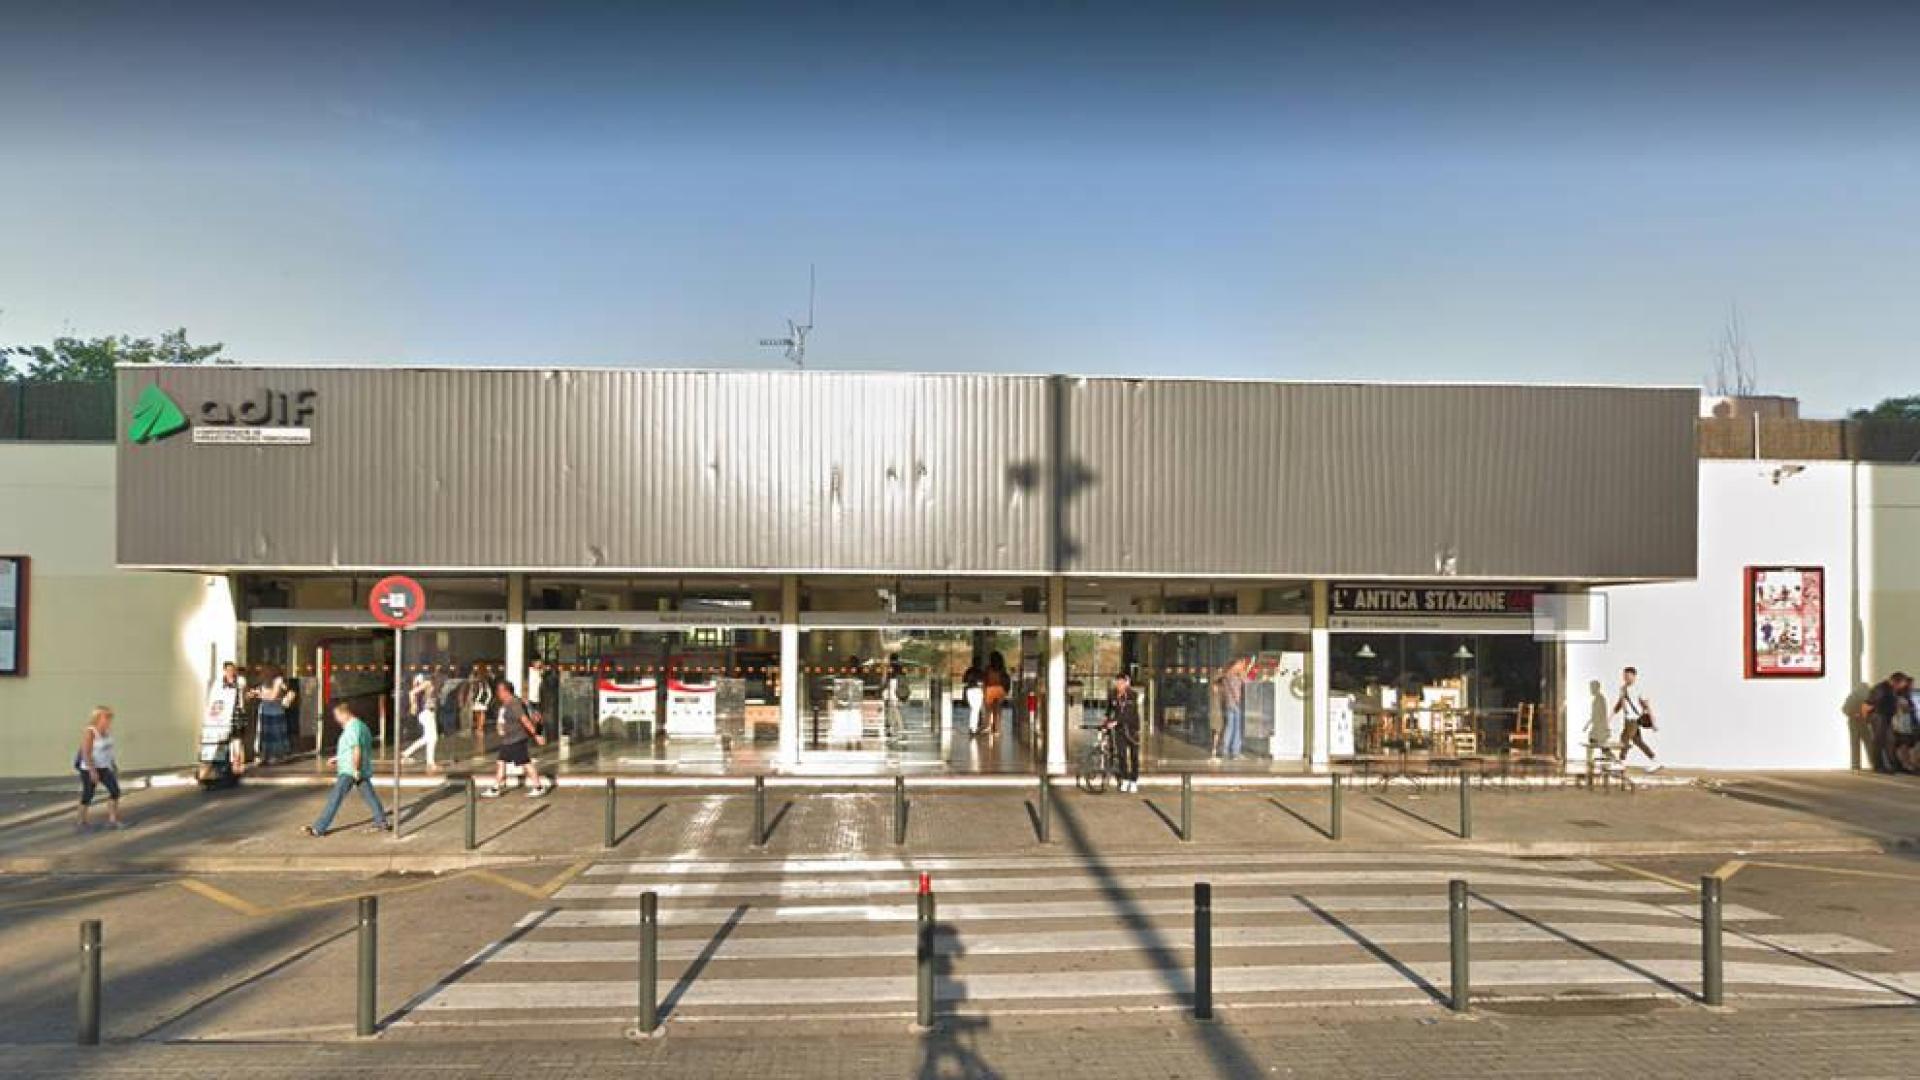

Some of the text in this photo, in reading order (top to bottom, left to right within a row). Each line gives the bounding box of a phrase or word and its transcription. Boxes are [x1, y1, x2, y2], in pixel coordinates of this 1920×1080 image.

[201, 387, 317, 426] adif
[1333, 590, 1506, 610] L' ANTICA STAZIONE
